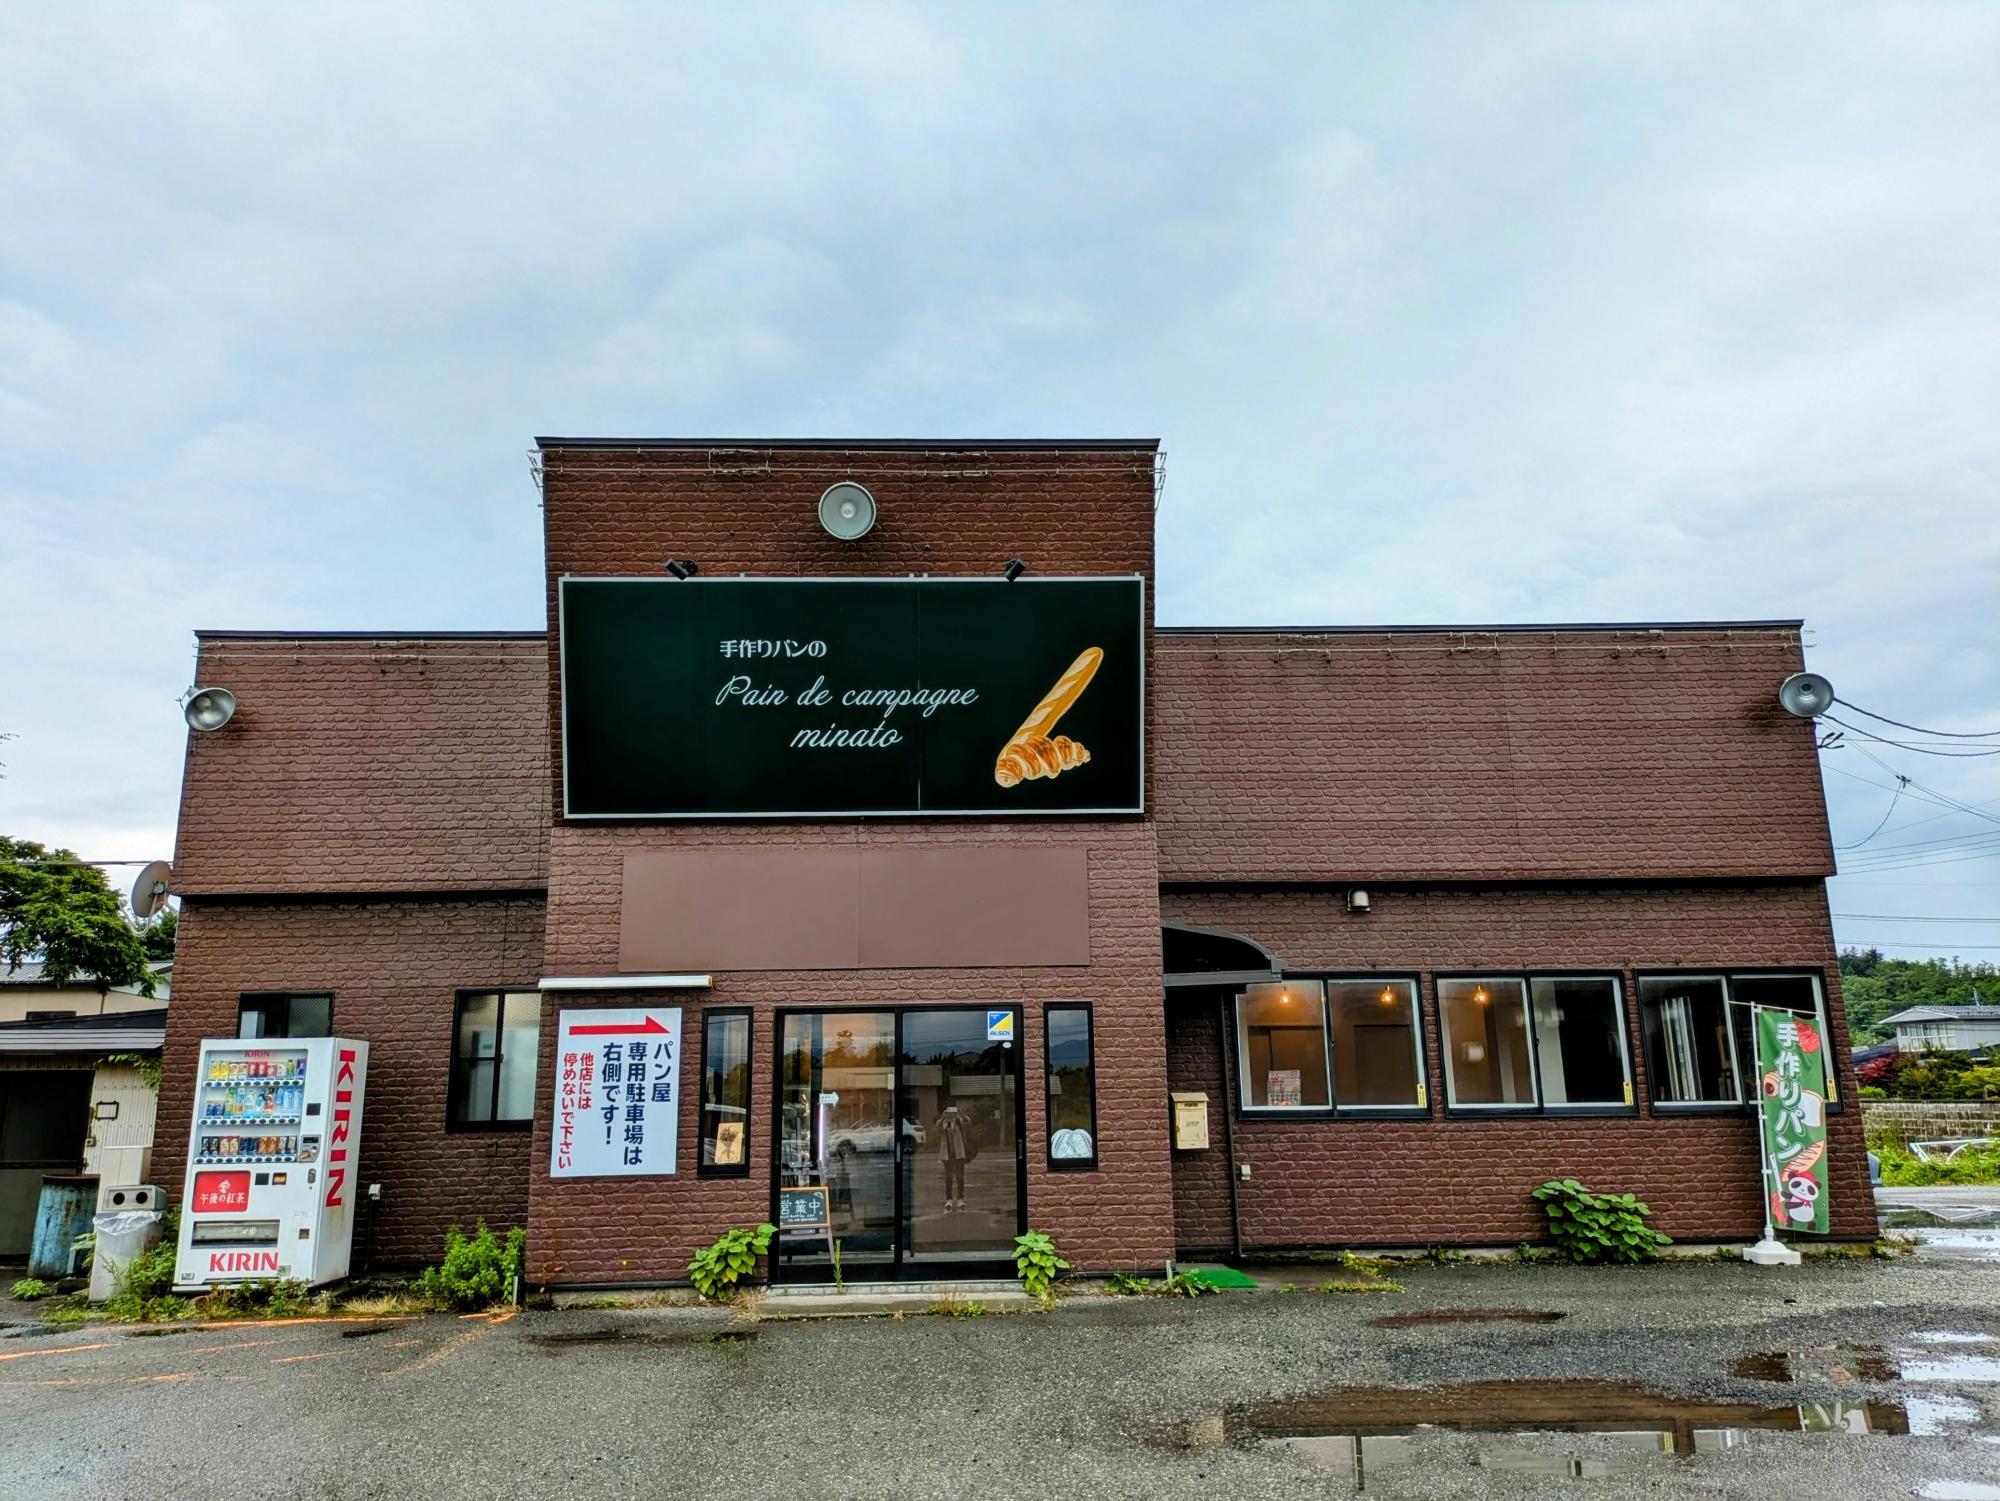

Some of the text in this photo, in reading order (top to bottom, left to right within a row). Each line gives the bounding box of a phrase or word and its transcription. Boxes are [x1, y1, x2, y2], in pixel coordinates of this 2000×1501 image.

[719, 639, 827, 658] 手作りパンの
[715, 675, 979, 718] Pain de campagne
[789, 720, 903, 748] minato
[243, 1049, 271, 1058] KIRIN
[577, 1052, 594, 1110] 他店には
[651, 1040, 674, 1103] パン屋
[558, 1052, 578, 1169] 停めないで下さい
[600, 1042, 623, 1145] 右側です！
[623, 1041, 648, 1166] 専用駐車場は
[1775, 1022, 1804, 1162] 手作りパン
[326, 1050, 356, 1208] KIRIN
[200, 1192, 246, 1205] 午後の紅茶
[209, 1252, 279, 1272] KIRIN
